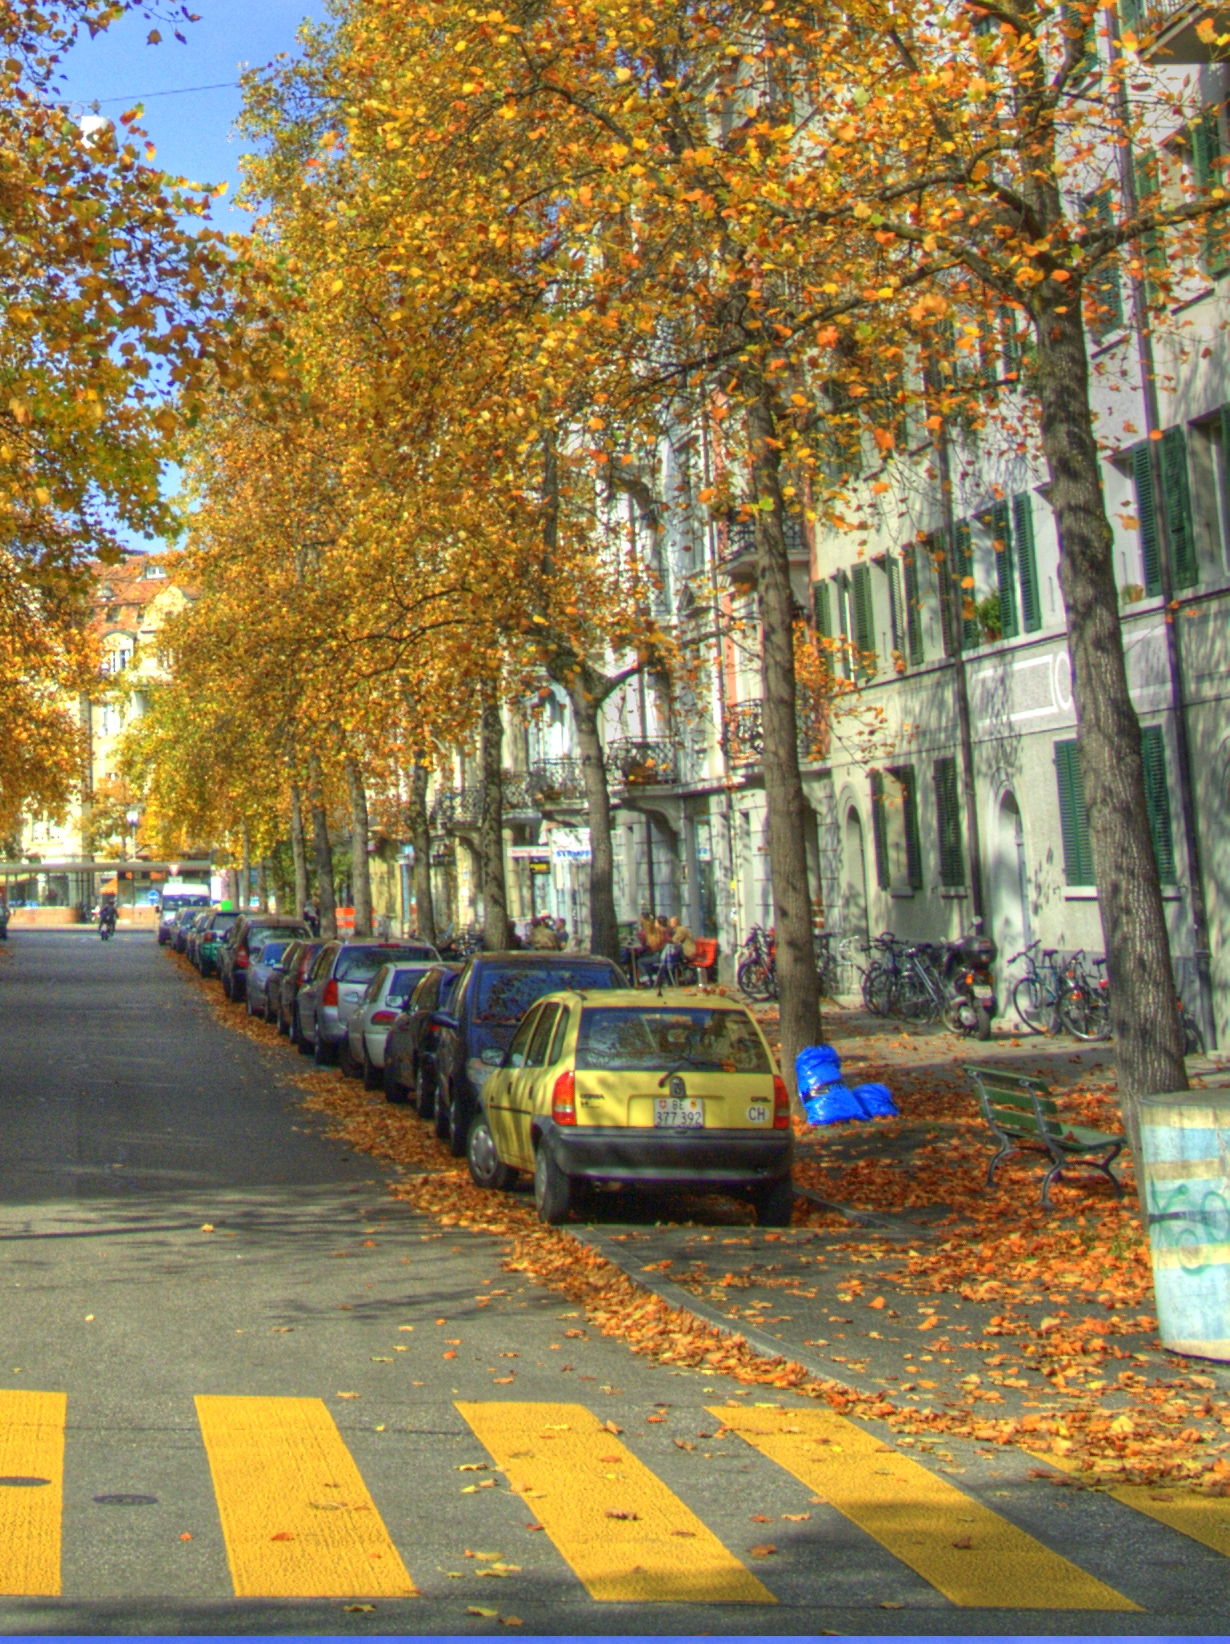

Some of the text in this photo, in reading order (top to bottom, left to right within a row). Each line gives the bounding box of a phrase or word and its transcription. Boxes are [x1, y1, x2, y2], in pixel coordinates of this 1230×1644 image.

[672, 1099, 684, 1110] BE
[657, 1111, 702, 1125] 377 392
[748, 1106, 766, 1121] CH
